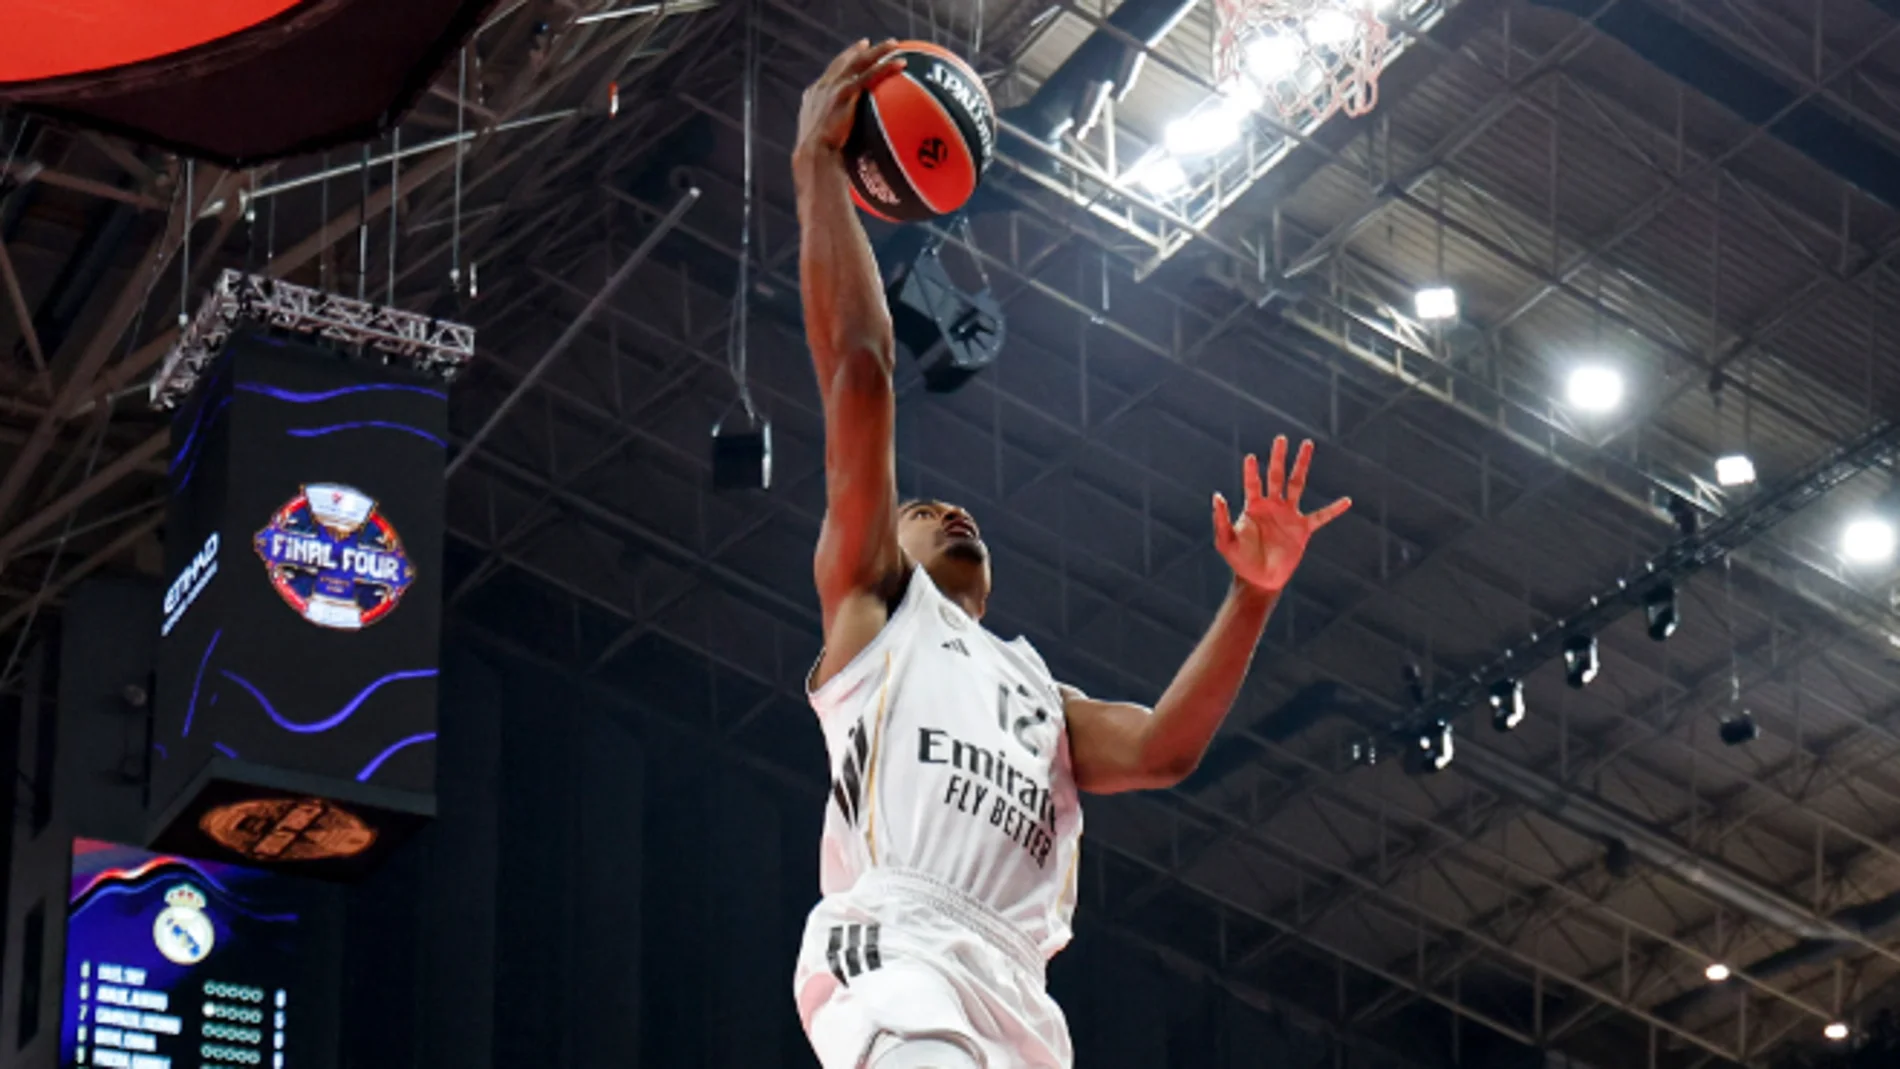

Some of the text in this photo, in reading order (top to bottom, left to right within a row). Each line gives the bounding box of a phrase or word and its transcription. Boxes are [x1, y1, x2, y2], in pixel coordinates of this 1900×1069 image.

[271, 534, 400, 581] FINAL FOUR
[944, 774, 1052, 870] FLY BETTER
